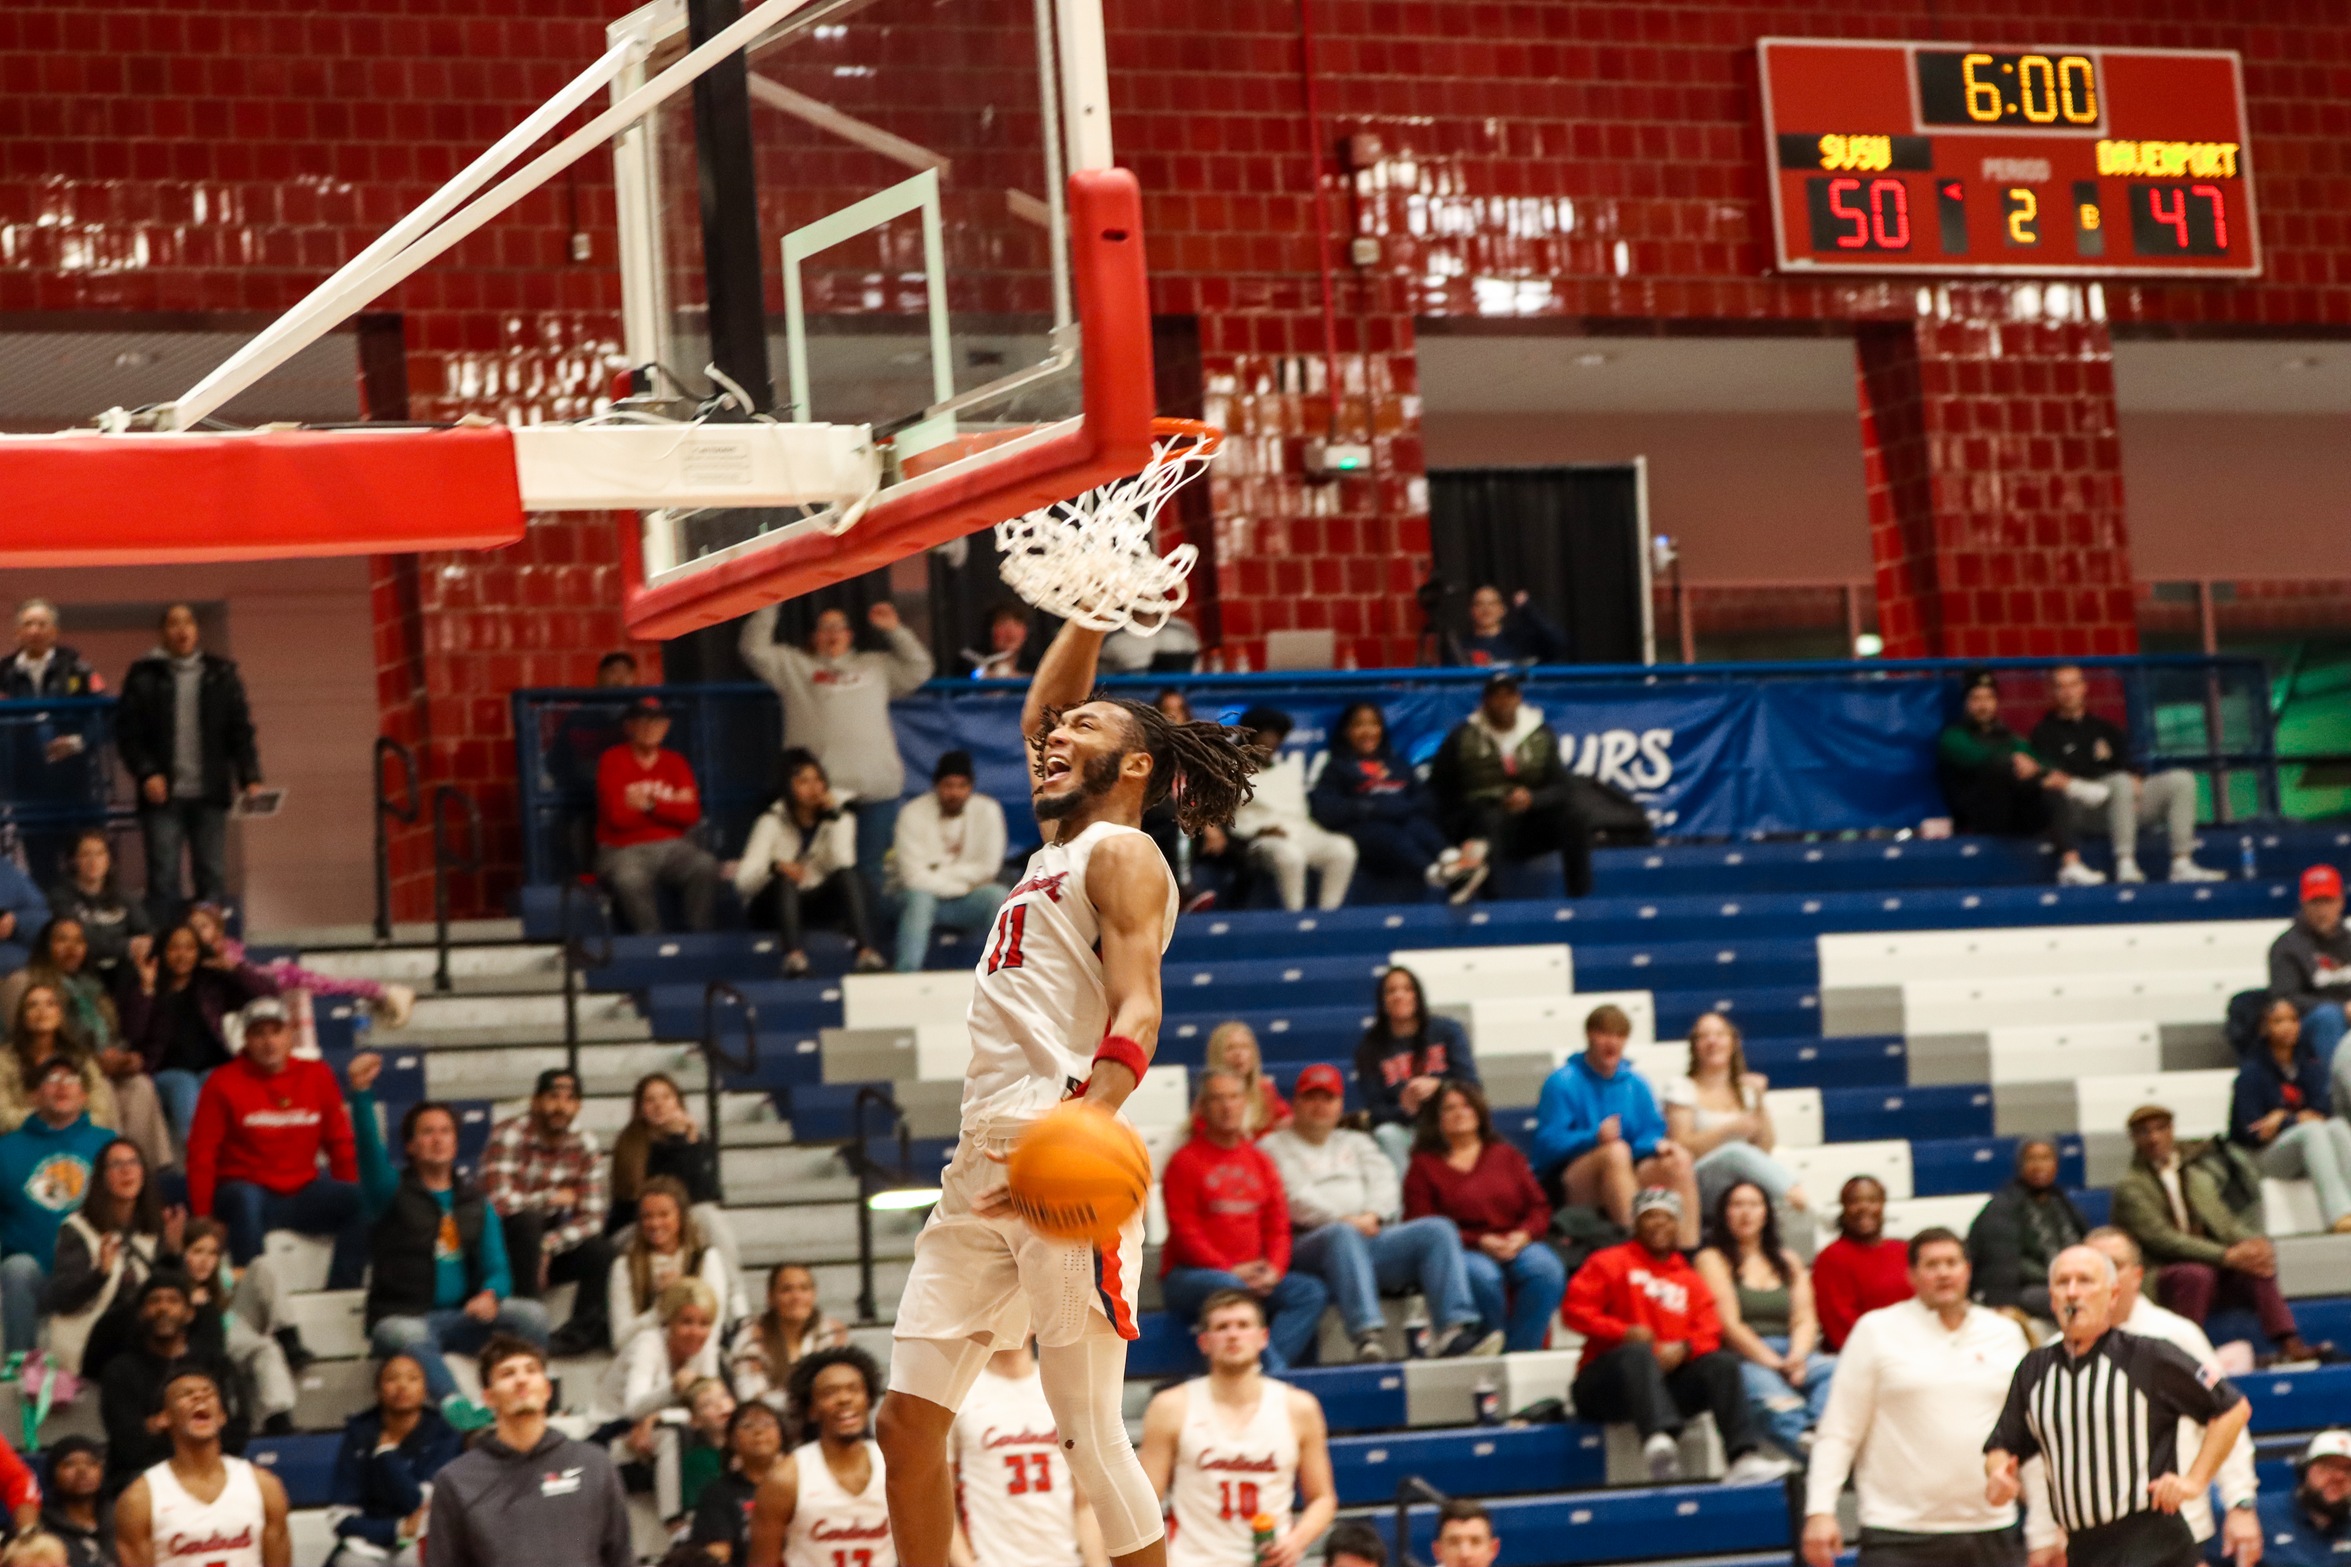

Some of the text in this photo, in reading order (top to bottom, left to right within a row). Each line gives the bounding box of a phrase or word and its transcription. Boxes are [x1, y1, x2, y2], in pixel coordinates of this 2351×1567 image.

[1961, 53, 2098, 123] 6:00
[1828, 178, 1910, 249] 50
[2008, 188, 2037, 243] 2
[2149, 184, 2228, 249] 47
[987, 903, 1027, 976] 11
[1004, 1452, 1053, 1496] 33
[1218, 1480, 1259, 1521] 10
